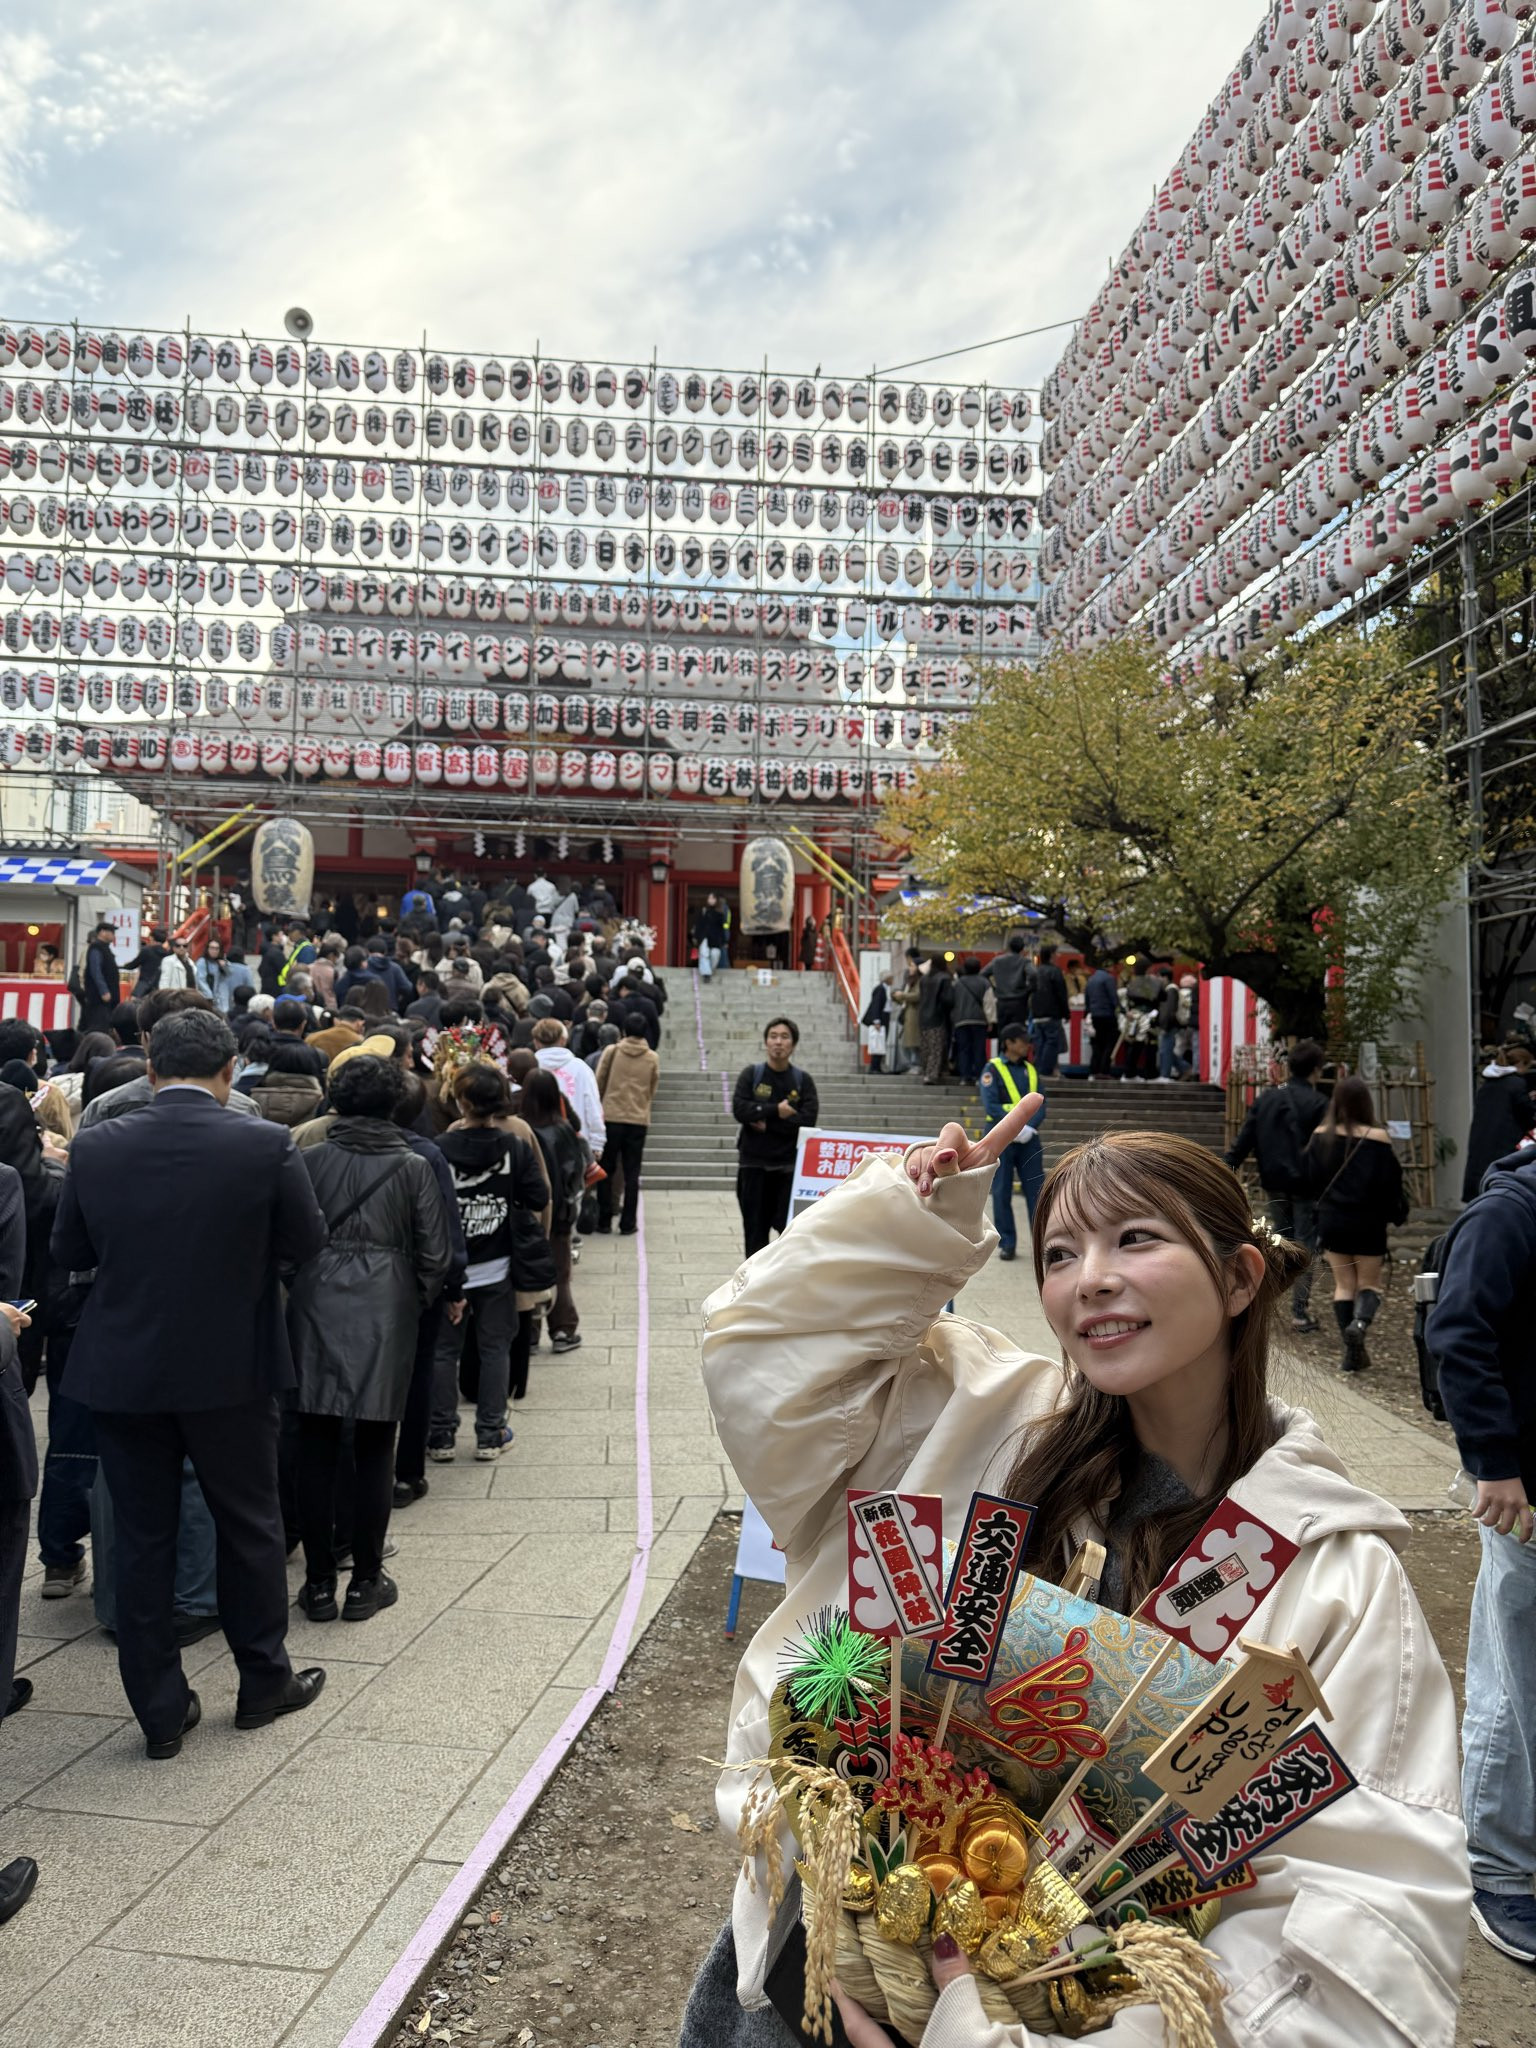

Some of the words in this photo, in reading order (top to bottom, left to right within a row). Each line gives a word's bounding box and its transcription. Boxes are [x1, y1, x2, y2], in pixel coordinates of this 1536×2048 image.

[863, 1502, 895, 1523] 新宿
[872, 1520, 936, 1626] 花園神社
[940, 1511, 1019, 1672] 交通安全
[1182, 1744, 1332, 1871] 家内安全
